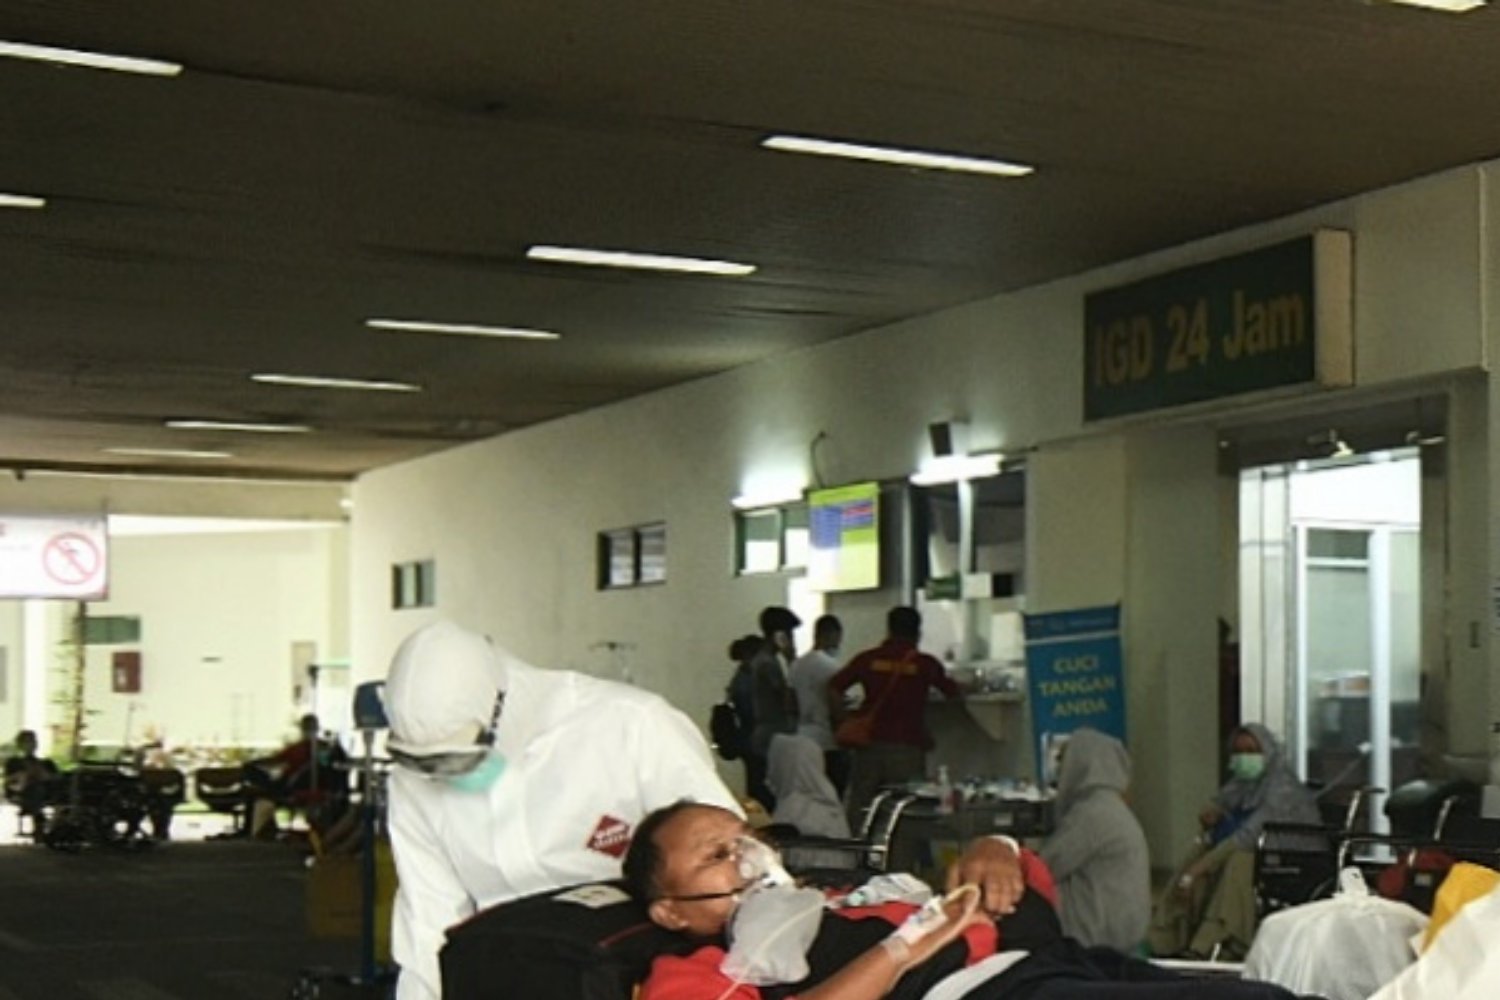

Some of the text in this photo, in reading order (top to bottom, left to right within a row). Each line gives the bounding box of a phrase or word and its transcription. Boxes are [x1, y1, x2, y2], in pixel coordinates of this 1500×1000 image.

[1095, 290, 1304, 386] IGD 24 Jam
[1053, 655, 1098, 674] CUCI
[1038, 675, 1115, 697] TANGAN
[1052, 698, 1108, 718] ANDA
